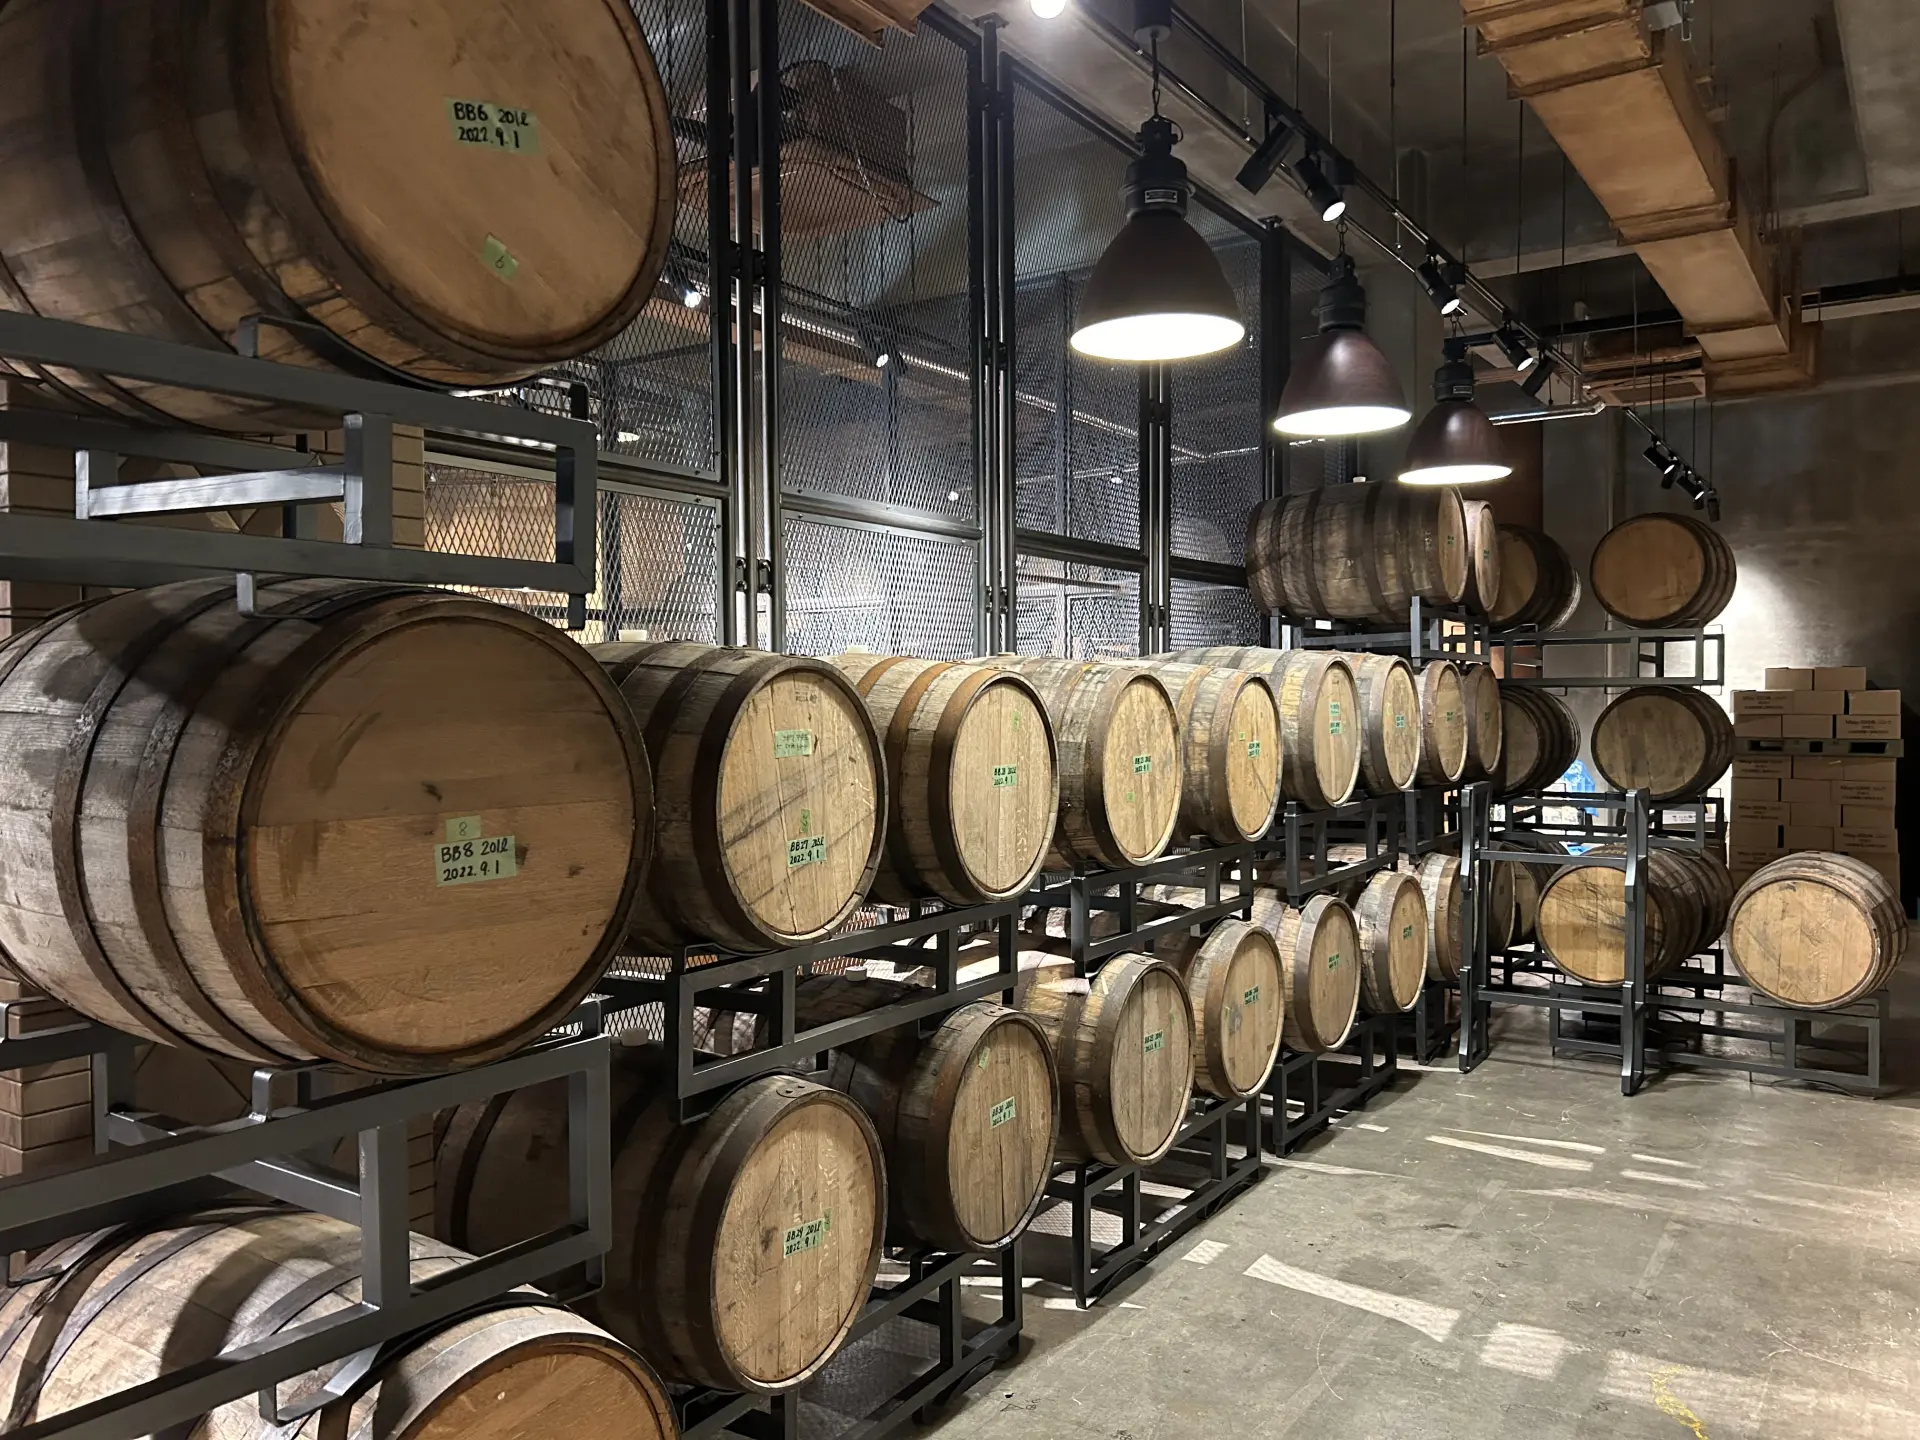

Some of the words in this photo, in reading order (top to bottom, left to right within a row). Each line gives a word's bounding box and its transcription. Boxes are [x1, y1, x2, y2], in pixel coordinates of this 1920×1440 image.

[453, 102, 488, 121] BB6
[494, 255, 505, 269] 6
[441, 842, 474, 863] BB8
